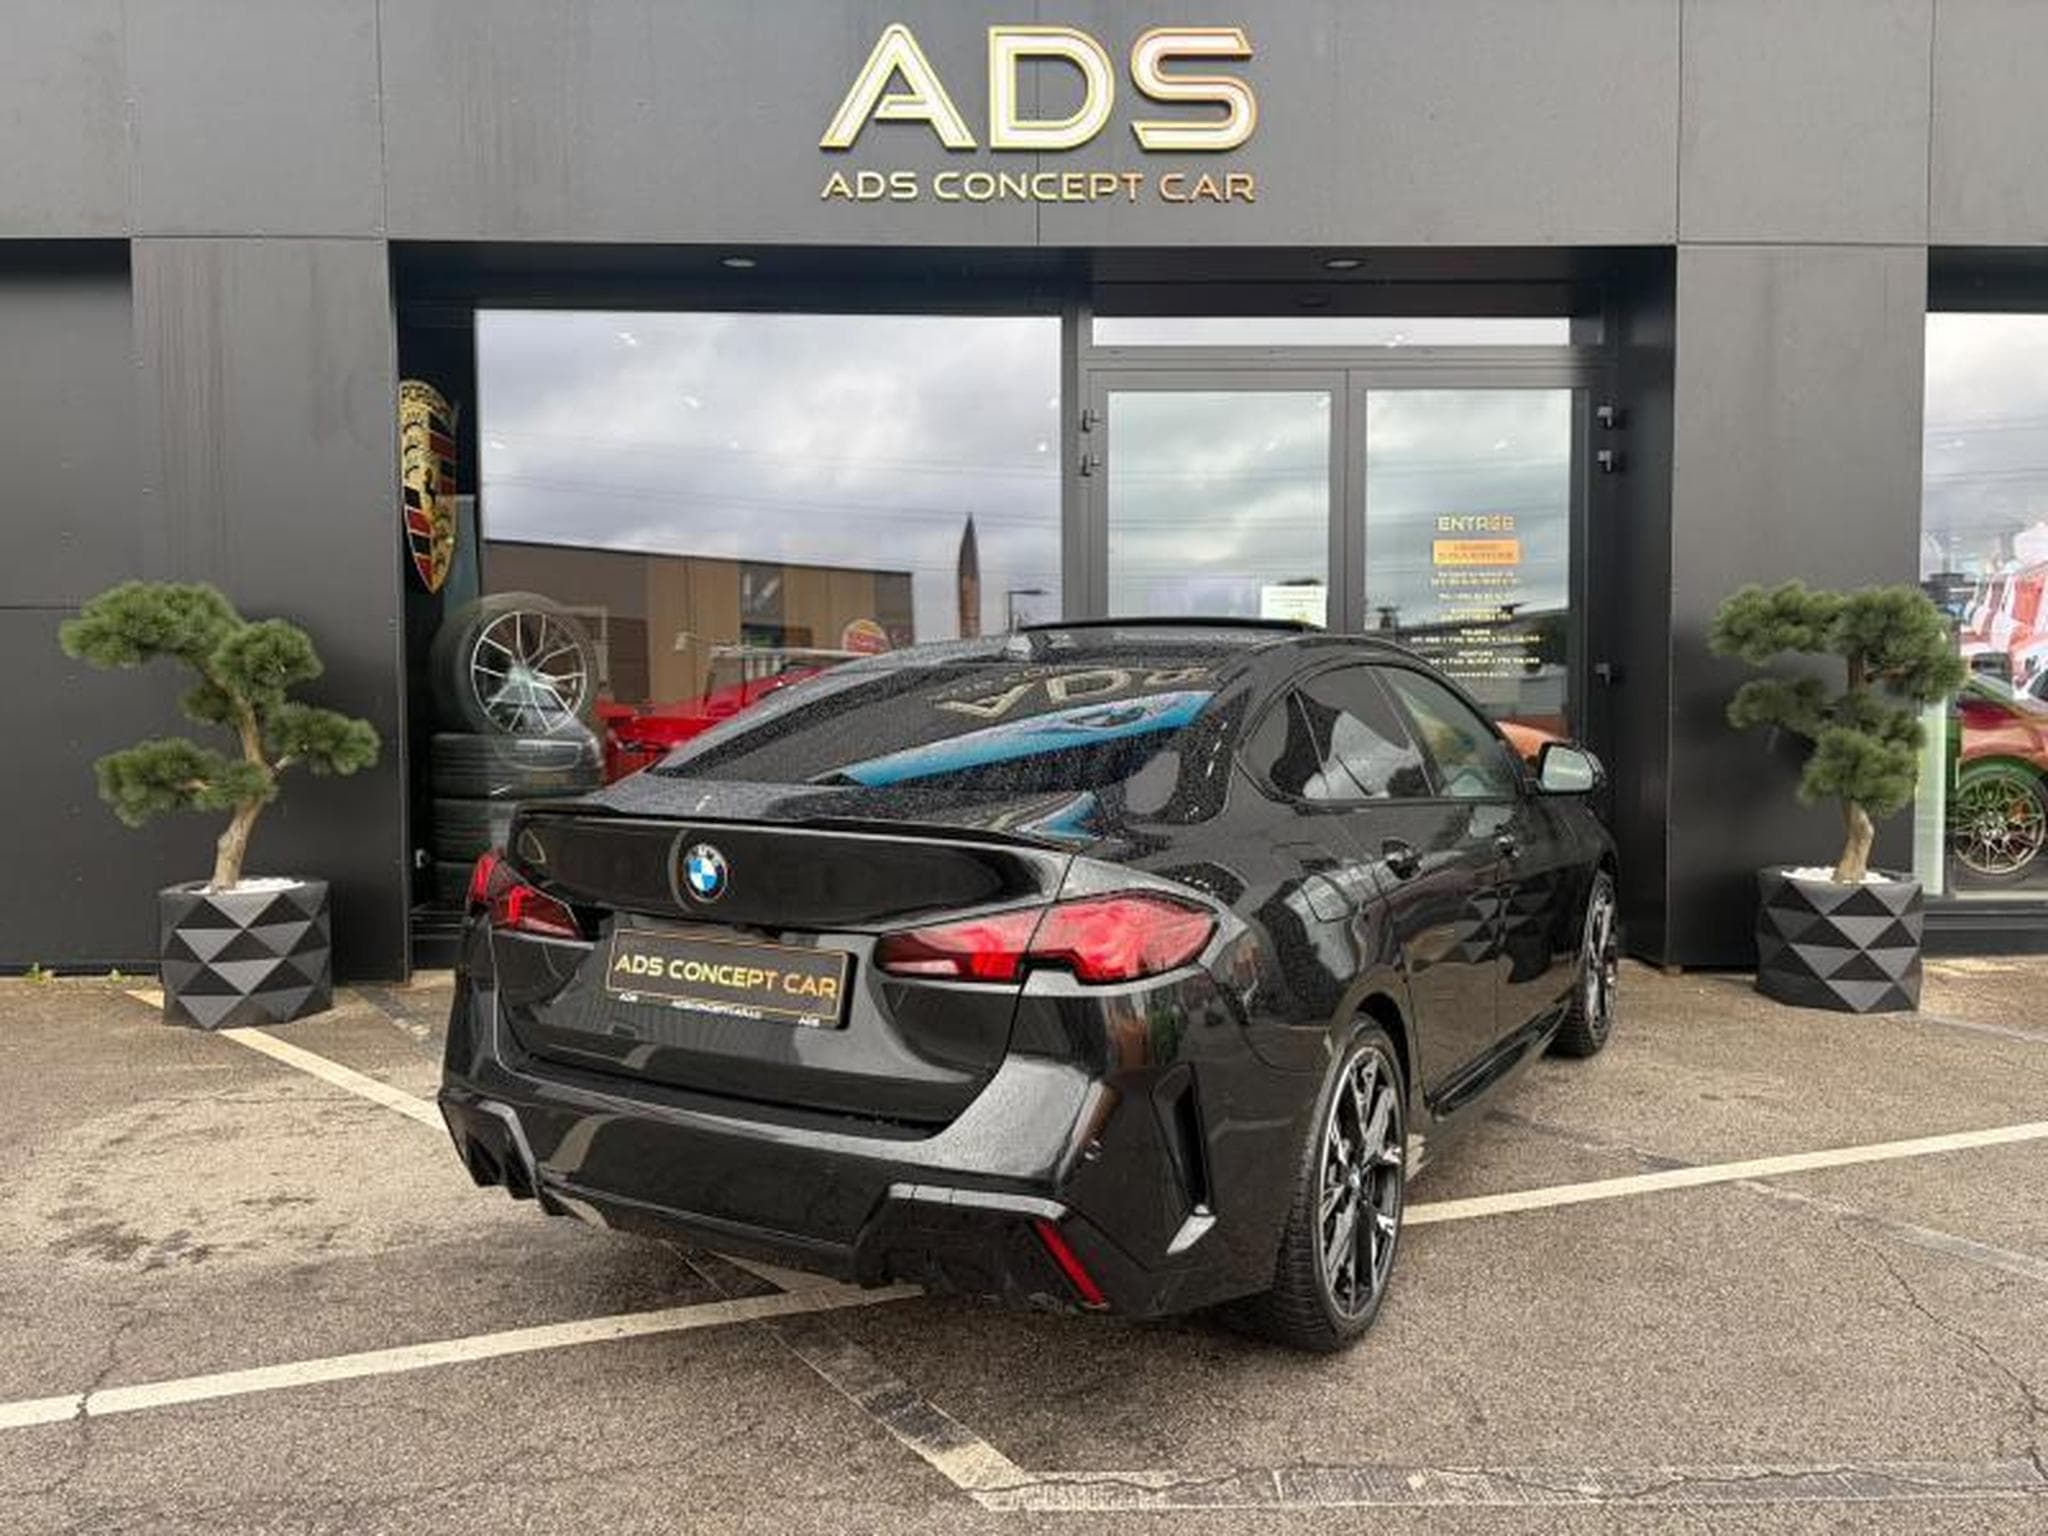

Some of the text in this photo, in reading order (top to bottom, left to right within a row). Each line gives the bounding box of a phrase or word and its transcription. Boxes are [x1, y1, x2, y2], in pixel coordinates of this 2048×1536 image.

[819, 22, 1258, 151] ADS
[821, 172, 1255, 202] ADS CONCEPT CAR
[614, 954, 838, 998] ADS CONCEPT CAR
